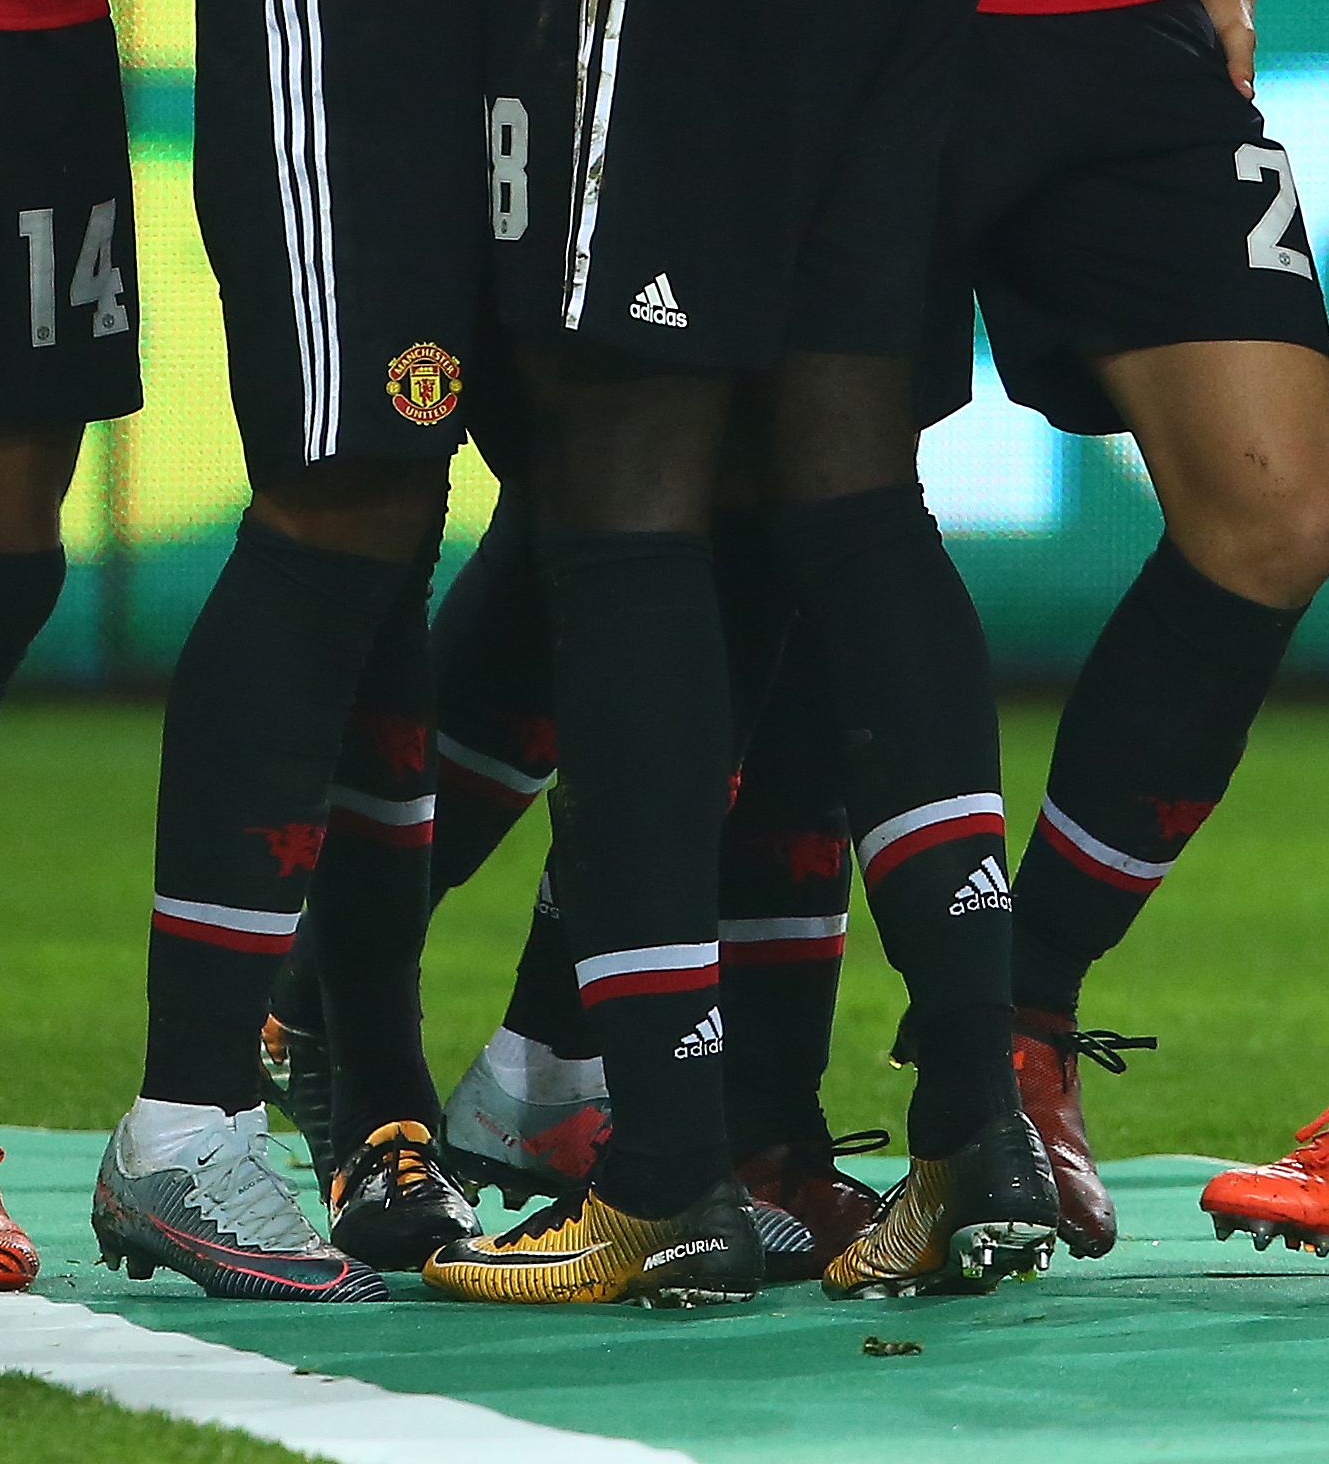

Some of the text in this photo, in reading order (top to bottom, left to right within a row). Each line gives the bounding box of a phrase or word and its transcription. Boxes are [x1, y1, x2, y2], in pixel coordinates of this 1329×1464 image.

[484, 93, 529, 241] 8
[19, 197, 130, 348] 14
[629, 303, 688, 328] adidas
[394, 348, 455, 375] MANCHESTER
[405, 404, 448, 419] UNITED
[948, 891, 1013, 916] adida
[674, 1038, 723, 1059] adid
